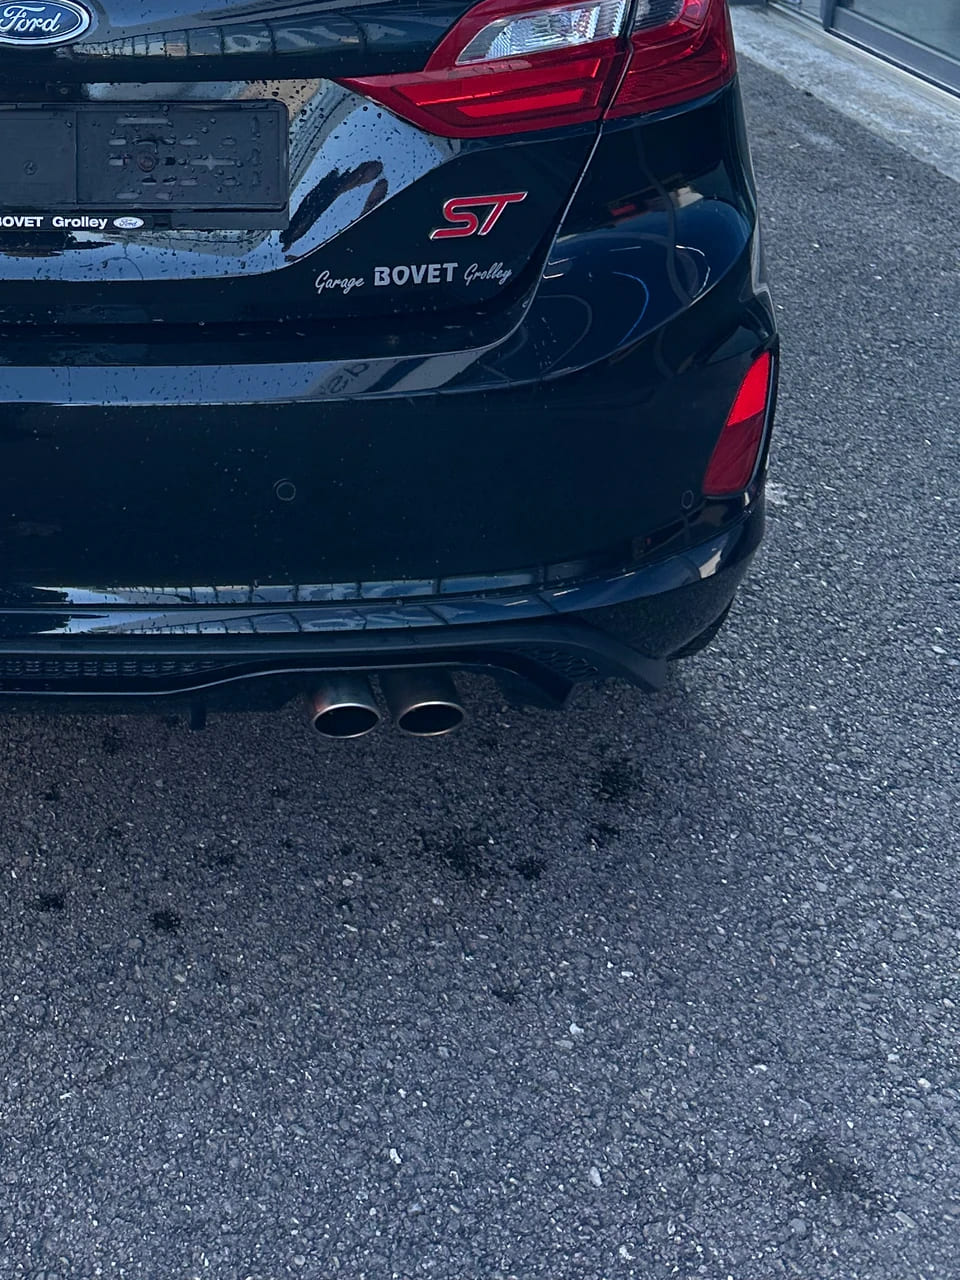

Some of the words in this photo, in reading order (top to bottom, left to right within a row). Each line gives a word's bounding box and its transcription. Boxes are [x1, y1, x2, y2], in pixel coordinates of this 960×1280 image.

[52, 216, 108, 230] Grolley
[429, 191, 528, 240] ST
[314, 270, 365, 294] Garage
[374, 262, 458, 286] BOVET
[464, 262, 513, 287] Grolley
